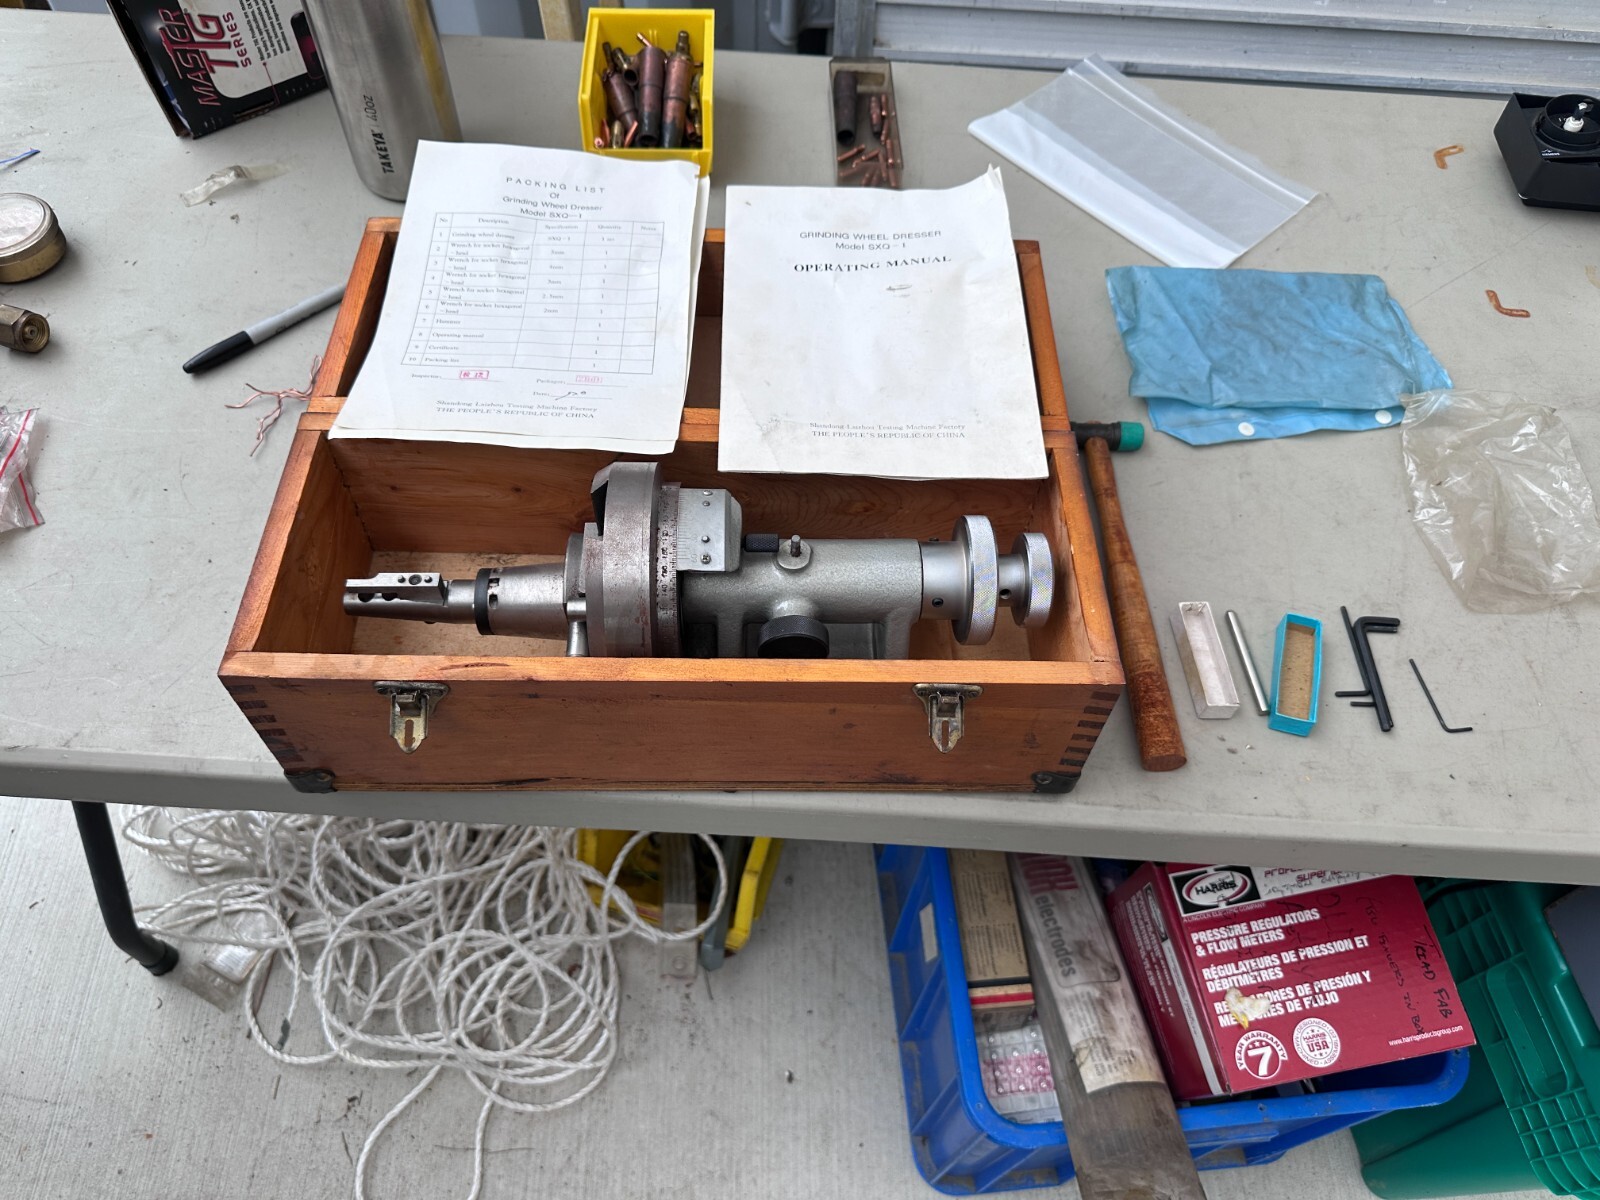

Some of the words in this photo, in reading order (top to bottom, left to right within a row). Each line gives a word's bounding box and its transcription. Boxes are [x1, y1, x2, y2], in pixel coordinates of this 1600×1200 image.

[183, 13, 239, 74] TIG
[222, 12, 252, 68] SERIES
[159, 8, 222, 106] MASTER
[371, 131, 395, 174] TAKEYA
[506, 177, 567, 190] PACKING
[575, 185, 606, 194] LIST
[502, 196, 538, 208] Grinding
[541, 201, 568, 210] Wheel
[520, 208, 546, 218] Model
[799, 231, 850, 240] GRINDING
[852, 233, 889, 241] WHEEL
[892, 230, 942, 240] DRESSER
[835, 242, 865, 251] Model
[794, 262, 880, 273] OPERATING
[886, 255, 952, 268] MANUAL
[832, 431, 876, 439] PEOPLE'S
[876, 431, 921, 440] REPUBLIC
[922, 431, 936, 439] OF
[936, 431, 966, 439] CHINA
[1194, 880, 1238, 895] HARRIS
[1188, 912, 1211, 922] LINCOLN
[1239, 902, 1266, 912] COMPANY
[1034, 894, 1077, 978] electrodes
[1190, 922, 1249, 945] PRESSURE
[1250, 908, 1321, 932] REGULATORS
[1195, 944, 1206, 958] &
[1206, 938, 1239, 956] FLOW
[1240, 928, 1286, 949] METERS
[1202, 955, 1280, 981] RÉGULATEURS
[1280, 950, 1298, 964] DE
[1299, 940, 1354, 961] PRESSION
[1354, 934, 1370, 948] ET
[1296, 982, 1313, 997] DE
[1314, 971, 1360, 994] PRESIÓN
[1360, 970, 1372, 982] Y
[1286, 998, 1303, 1014] DE
[1304, 990, 1340, 1010] FLUJO
[1434, 988, 1454, 1020] FAB
[1296, 1018, 1328, 1034] DESIGNED
[1302, 1032, 1327, 1041] HARRIS
[1388, 1024, 1464, 1046] www.harrisproductsgroup.com
[1236, 1042, 1245, 1068] YEAR
[1243, 1032, 1287, 1060] WARRANTY
[1306, 1040, 1330, 1053] USA
[1247, 1045, 1273, 1076] 7
